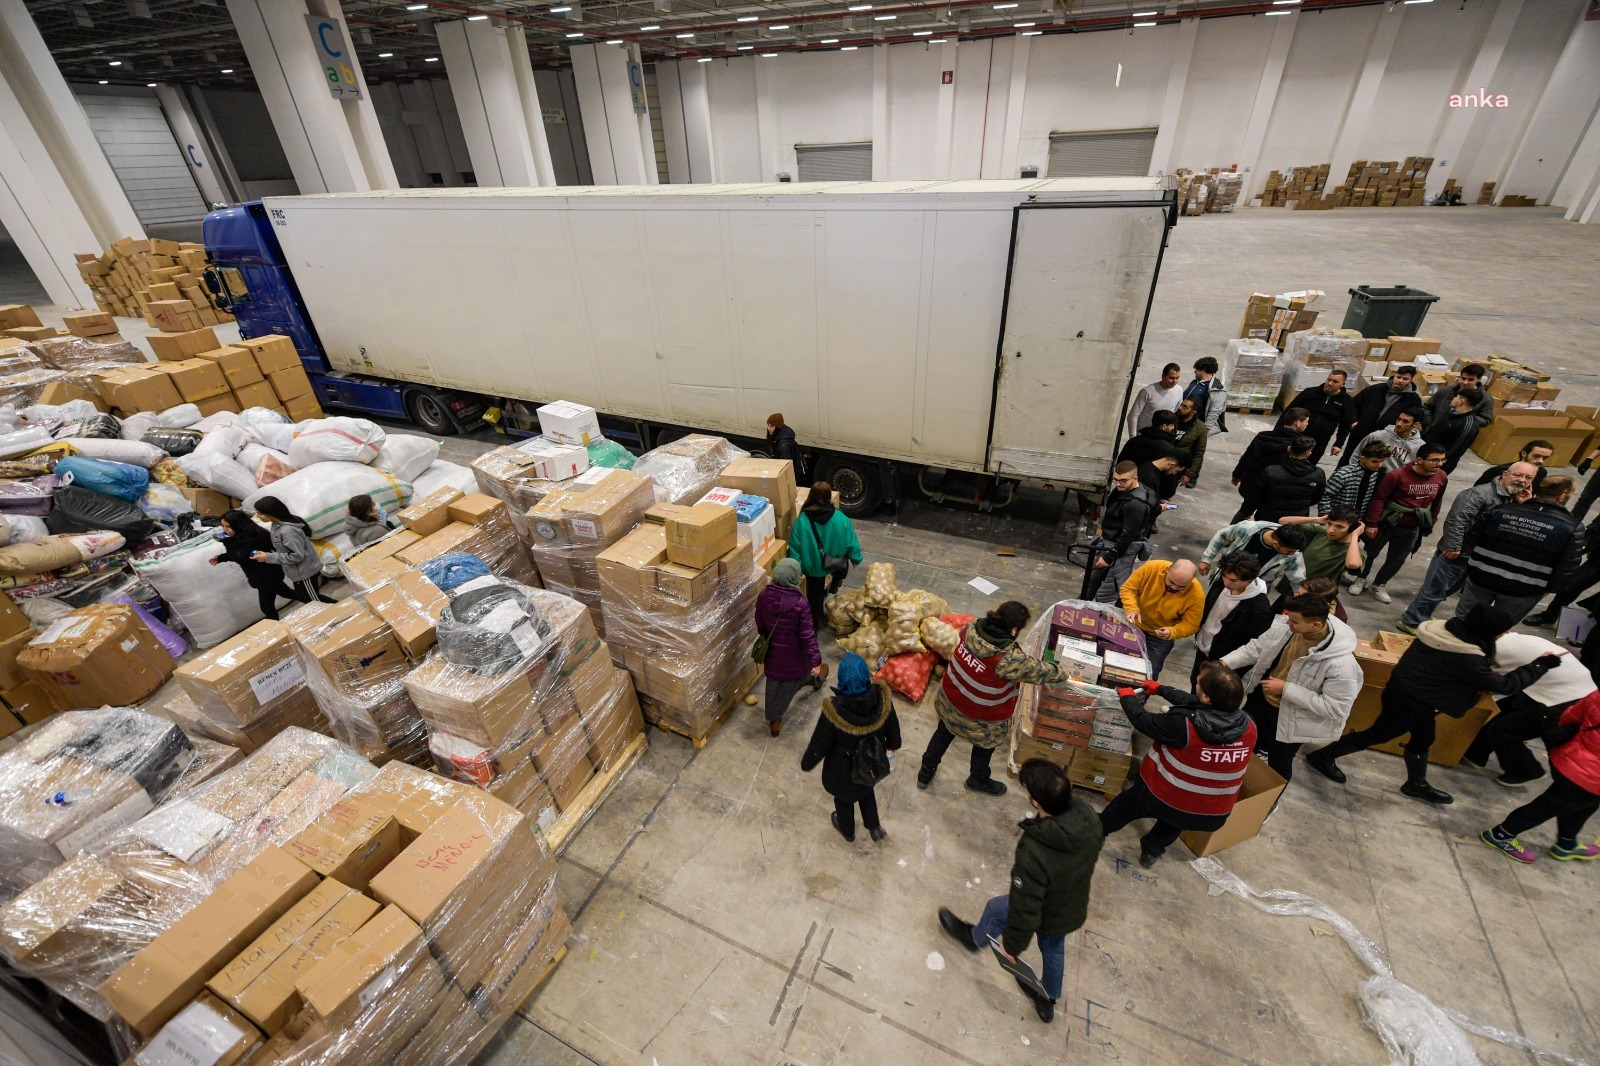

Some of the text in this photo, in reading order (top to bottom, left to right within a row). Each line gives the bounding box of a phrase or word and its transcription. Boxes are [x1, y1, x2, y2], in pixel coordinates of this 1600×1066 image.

[318, 22, 341, 57] C
[327, 62, 355, 85] a b
[631, 64, 640, 87] C
[187, 144, 203, 168] C
[271, 209, 286, 219] FRC
[705, 493, 731, 503] HYPO
[1407, 483, 1439, 495] NIKE
[957, 643, 986, 673] STAFF
[257, 670, 278, 685] BEBEK
[1200, 750, 1250, 763] STAFF
